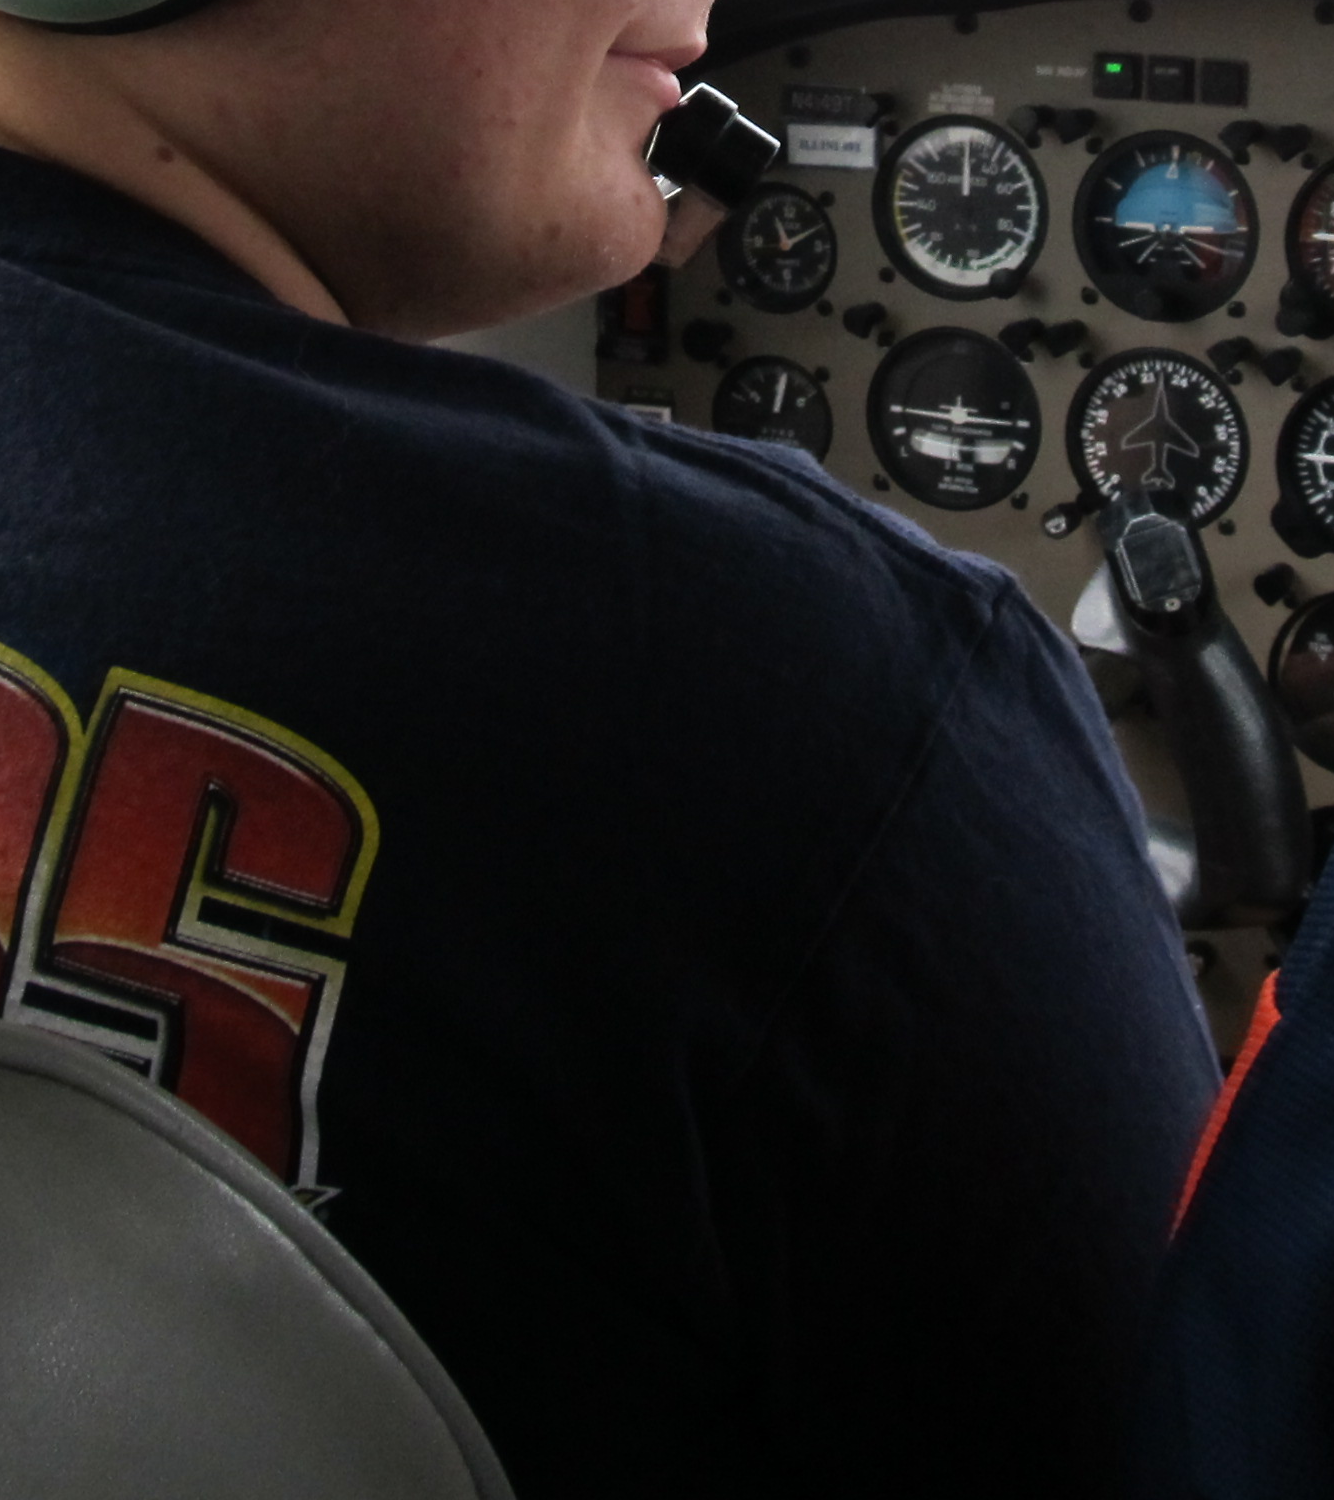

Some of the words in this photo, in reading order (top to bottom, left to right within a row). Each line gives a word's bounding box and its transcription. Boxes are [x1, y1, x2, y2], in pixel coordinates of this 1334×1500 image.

[981, 163, 999, 175] 40
[997, 218, 1014, 231] 80
[1170, 373, 1189, 388] 24
[1198, 395, 1216, 409] 27
